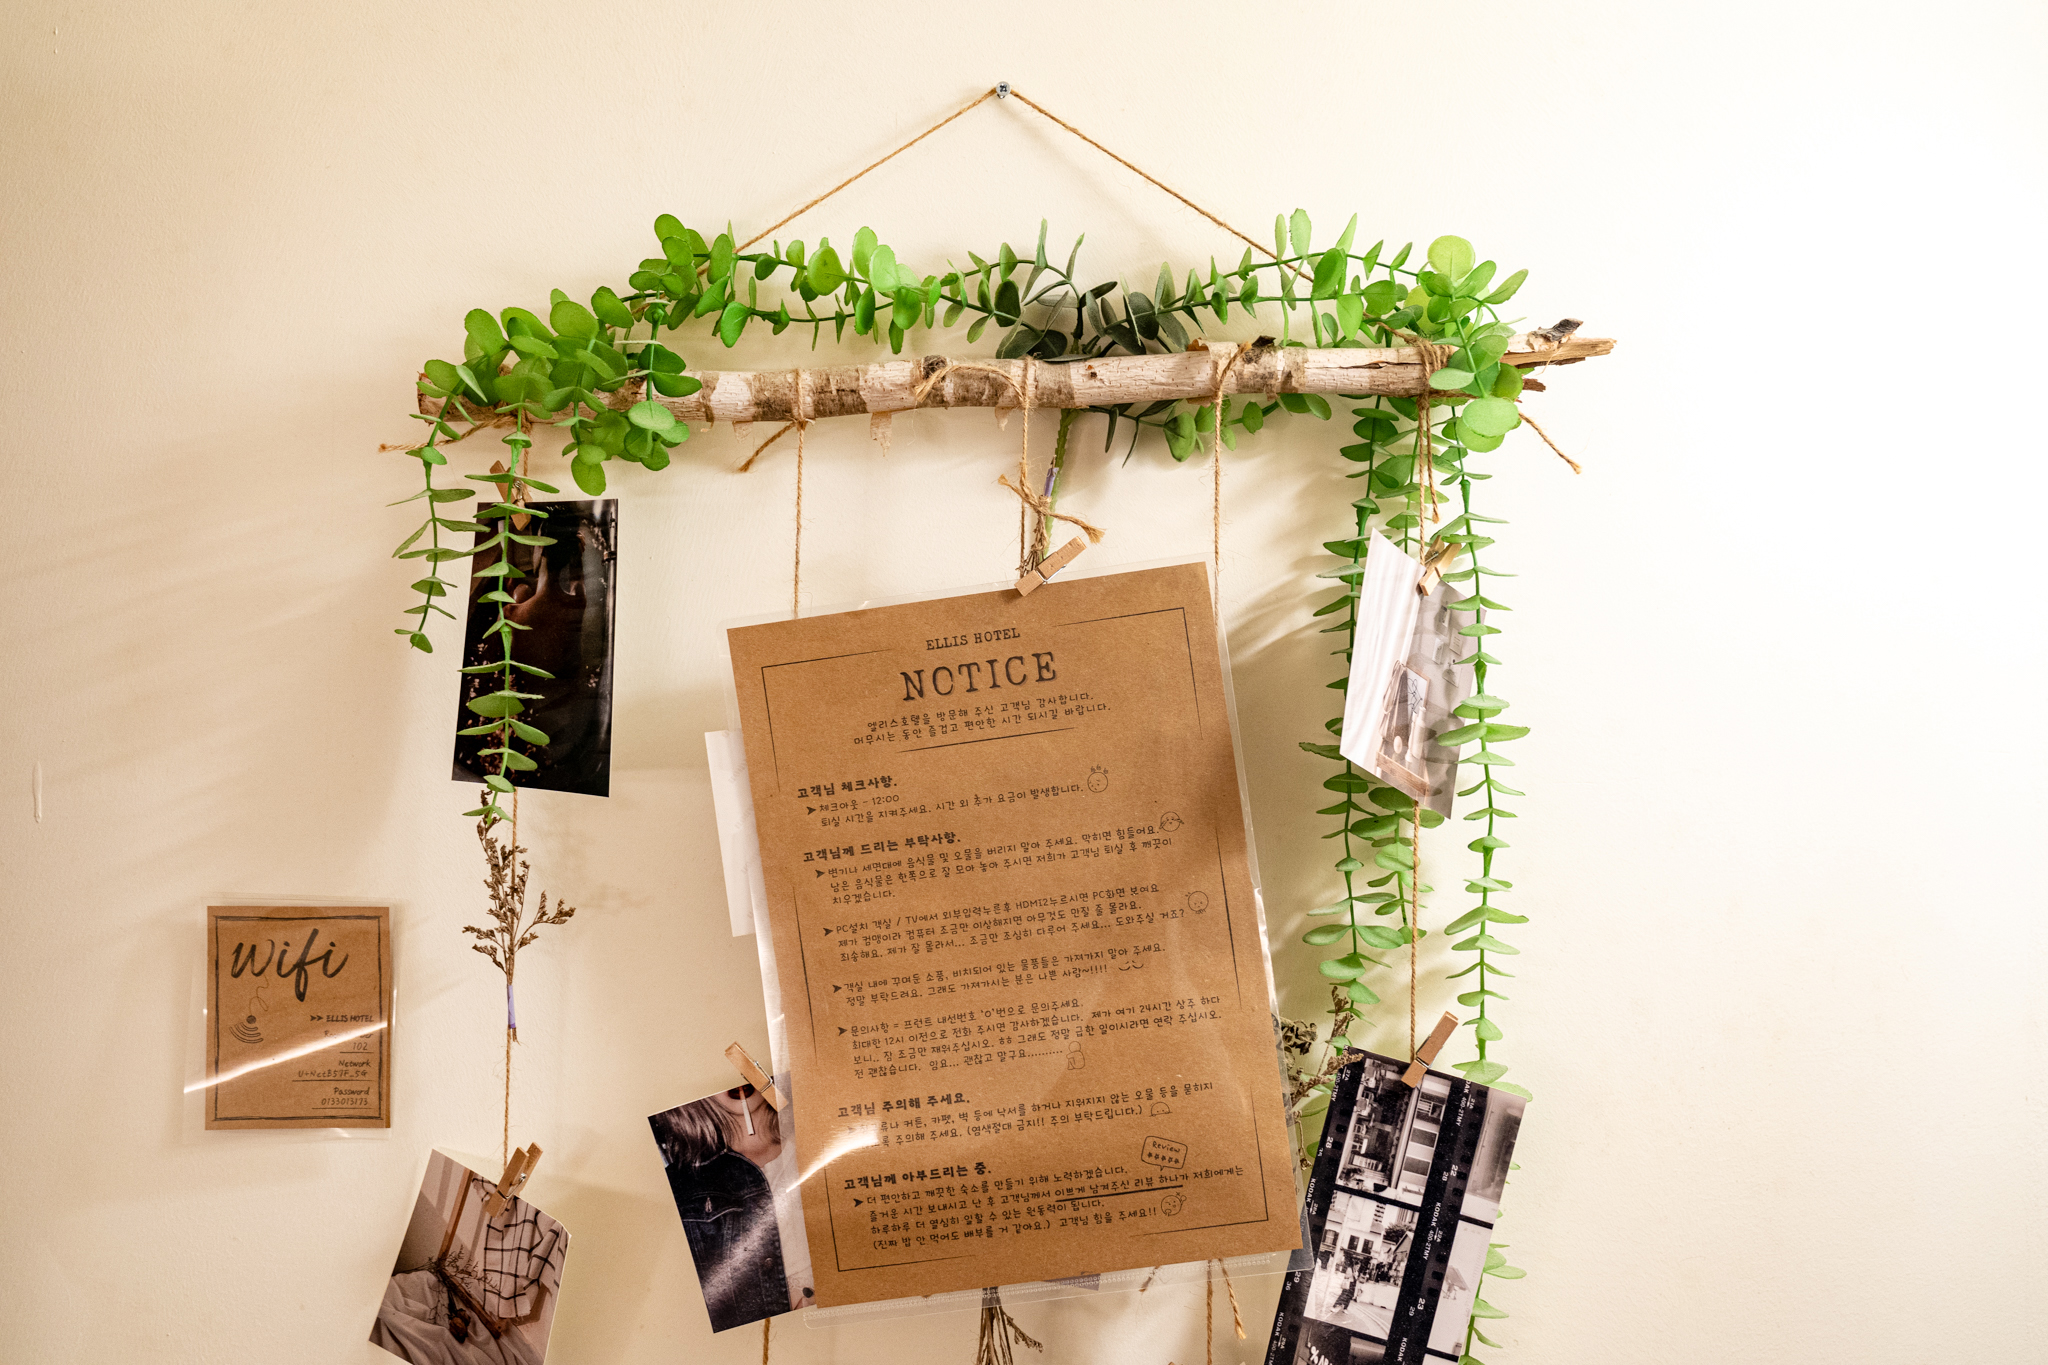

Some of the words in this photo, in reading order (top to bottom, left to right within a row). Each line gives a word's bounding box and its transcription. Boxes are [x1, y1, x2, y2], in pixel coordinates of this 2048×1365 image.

[925, 634, 968, 650] ELLIS
[973, 627, 1020, 644] HOTEL
[899, 651, 1057, 701] NOTICE
[936, 708, 968, 721] 방문해
[1000, 700, 1030, 712] 고객님
[1036, 692, 1093, 708] 감사합니다.
[853, 731, 895, 745] 머무시는
[899, 728, 922, 741] 동안
[963, 716, 995, 730] 편안한
[1027, 708, 1058, 720] 되시길
[797, 782, 835, 798] 고객님
[841, 775, 897, 792] 체크사항.
[819, 799, 858, 811] 체크아웃
[871, 794, 899, 805] 12:00
[845, 810, 873, 823] 시간을
[878, 804, 931, 818] 지켜주세요.
[973, 793, 992, 806] 추가
[997, 791, 1026, 803] 요금이
[1029, 784, 1083, 799] 발생합니다.
[803, 845, 854, 862] 고객님께
[860, 839, 898, 854] 드리는
[904, 831, 960, 848] 부탁사항.
[827, 866, 857, 878] 변기나
[862, 860, 901, 872] 세면대에
[906, 853, 934, 868] 음식물
[953, 847, 982, 861] 오물을
[986, 844, 1016, 855] 버리지
[1045, 836, 1077, 849] 주세요.
[1081, 830, 1111, 843] 막히면
[1115, 825, 1159, 840] 힘들어요.
[855, 874, 892, 890] 음식물은
[897, 868, 937, 883] 한쪽으로
[1003, 855, 1031, 869] 주시면
[1036, 851, 1066, 862] 저희가
[1070, 847, 1099, 859] 고객님
[1141, 837, 1171, 849] 깨끗이
[832, 889, 895, 904] 치우겠습니다.
[836, 922, 868, 934] PC설치
[904, 912, 938, 924] TV에서
[1092, 887, 1125, 900] PC화면
[1130, 883, 1159, 895] 보여요
[905, 927, 935, 940] 컴퓨터
[940, 922, 968, 934] 조금만
[972, 915, 1022, 929] 이상해지면
[1026, 909, 1066, 922] 아무것도
[1108, 900, 1141, 914] 몰라요.
[840, 949, 883, 962] 죄송해요.
[969, 932, 998, 945] 조금만
[1003, 928, 1032, 940] 조심히
[1036, 924, 1066, 935] 다루어
[1115, 911, 1154, 926] 도와주실
[1159, 908, 1184, 919] 거죠?
[952, 965, 992, 977] 비치되어
[1063, 950, 1103, 962] 가져가지
[1133, 942, 1165, 955] 주세요.
[870, 988, 922, 1003] 부탁드려요.
[927, 983, 956, 995] 그래도
[960, 976, 1009, 989] 가져가시는
[326, 1014, 348, 1022] ELLIS
[350, 1014, 374, 1022] HOTEL
[851, 1021, 889, 1036] 문의사항
[904, 1016, 932, 1029] 프런트
[937, 1010, 976, 1024] 내선번호
[852, 1038, 881, 1049] 최대한
[908, 1029, 948, 1042] 이전으로
[977, 1021, 1005, 1035] 주시면
[1009, 1013, 1083, 1031] 감사하겠습니다.
[1139, 1001, 1171, 1013] 24시간
[898, 1046, 926, 1059] 조금만
[1017, 1031, 1046, 1043] 그래도
[1075, 1024, 1094, 1037] 급한
[1098, 1018, 1149, 1035] 일이시라면
[1152, 1015, 1173, 1027] 연락
[1178, 1009, 1221, 1024] 주십시오.
[338, 1059, 371, 1067] Network
[333, 1086, 370, 1095] Password
[837, 1101, 875, 1117] 고객님
[881, 1097, 921, 1112] 주의해
[926, 1092, 970, 1107] 주세요.
[996, 1103, 1026, 1117] 낙서를
[1030, 1101, 1061, 1112] 하거나
[1065, 1095, 1105, 1107] 지워지지
[1109, 1091, 1129, 1104] 않는
[895, 1131, 925, 1145] 주의해
[930, 1127, 962, 1141] 주세요.
[1016, 1117, 1044, 1131] 금지!!
[1074, 1104, 1142, 1123] 부탁드립니다.)
[1152, 1140, 1181, 1153] Review
[1325, 1135, 1334, 1149] 28
[843, 1173, 897, 1190] 고객님께
[901, 1164, 968, 1182] 아부드리는
[880, 1190, 920, 1204] 편안하고
[924, 1185, 955, 1198] 깨끗한
[960, 1180, 989, 1195] 숙소를
[993, 1177, 1024, 1190] 만들기
[1053, 1165, 1127, 1182] 노력하겠습니다.
[1305, 1177, 1316, 1203] KODAK
[869, 1208, 898, 1222] 즐거운
[927, 1200, 967, 1213] 보내시고
[1000, 1189, 1050, 1204] 고객님께서
[1054, 1186, 1085, 1196] 이쁘게
[1089, 1179, 1129, 1194] 남겨주신
[1158, 1173, 1189, 1183] 하나가
[1192, 1165, 1243, 1179] 저희에게는
[870, 1221, 910, 1234] 하루하루
[929, 1216, 959, 1229] 열심히
[1026, 1203, 1066, 1217] 원동력이
[1070, 1199, 1104, 1211] 됩니다.
[1430, 1201, 1442, 1227] KODAK
[873, 1239, 897, 1250] (진짜
[929, 1230, 959, 1243] 먹어도
[1012, 1219, 1050, 1234] 같아요.)
[1059, 1215, 1088, 1227] 고객님
[1093, 1211, 1112, 1224] 힘을
[1118, 1206, 1156, 1221] 주세요!!
[1293, 1269, 1302, 1283] 29
[1416, 1297, 1426, 1310] 23
[1274, 1311, 1285, 1337] KODAK
[1396, 1336, 1408, 1362] KODAK
